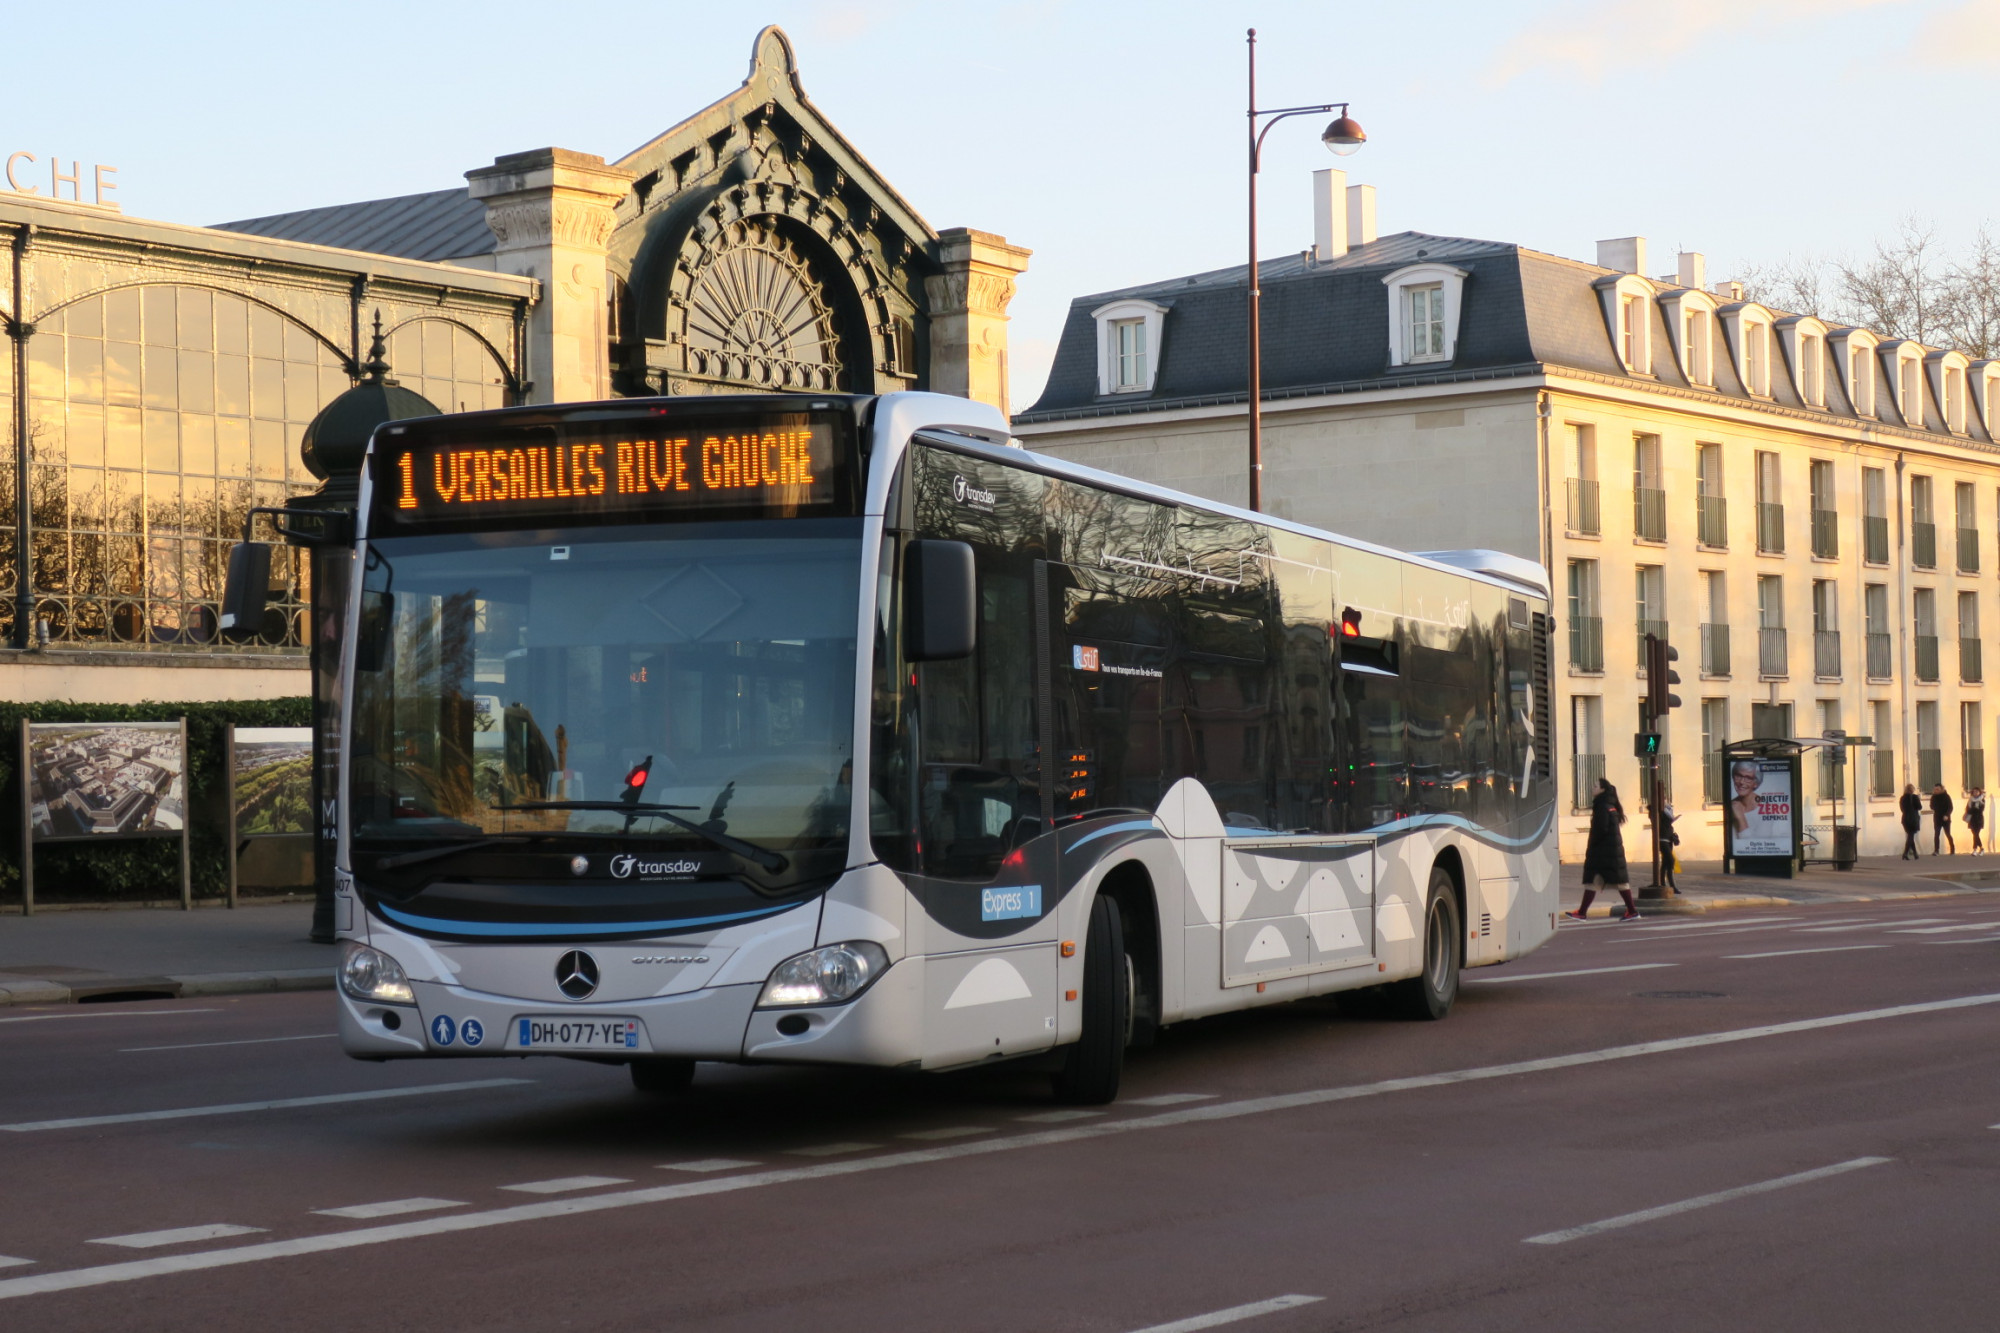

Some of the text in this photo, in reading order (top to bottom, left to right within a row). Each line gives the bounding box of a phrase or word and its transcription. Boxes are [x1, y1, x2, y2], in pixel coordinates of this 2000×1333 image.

[399, 431, 814, 508] 1 VERSAILLES RIVE GAUCHE
[966, 484, 996, 504] transdev
[1083, 649, 1098, 669] stif
[1118, 665, 1136, 676] transports
[1755, 794, 1789, 804] OBJECTIF
[637, 860, 700, 874] transdev
[1029, 891, 1034, 910] 1
[631, 956, 710, 964] CITARO
[531, 1023, 624, 1044] DH-077-YE
[626, 1035, 636, 1044] 78
